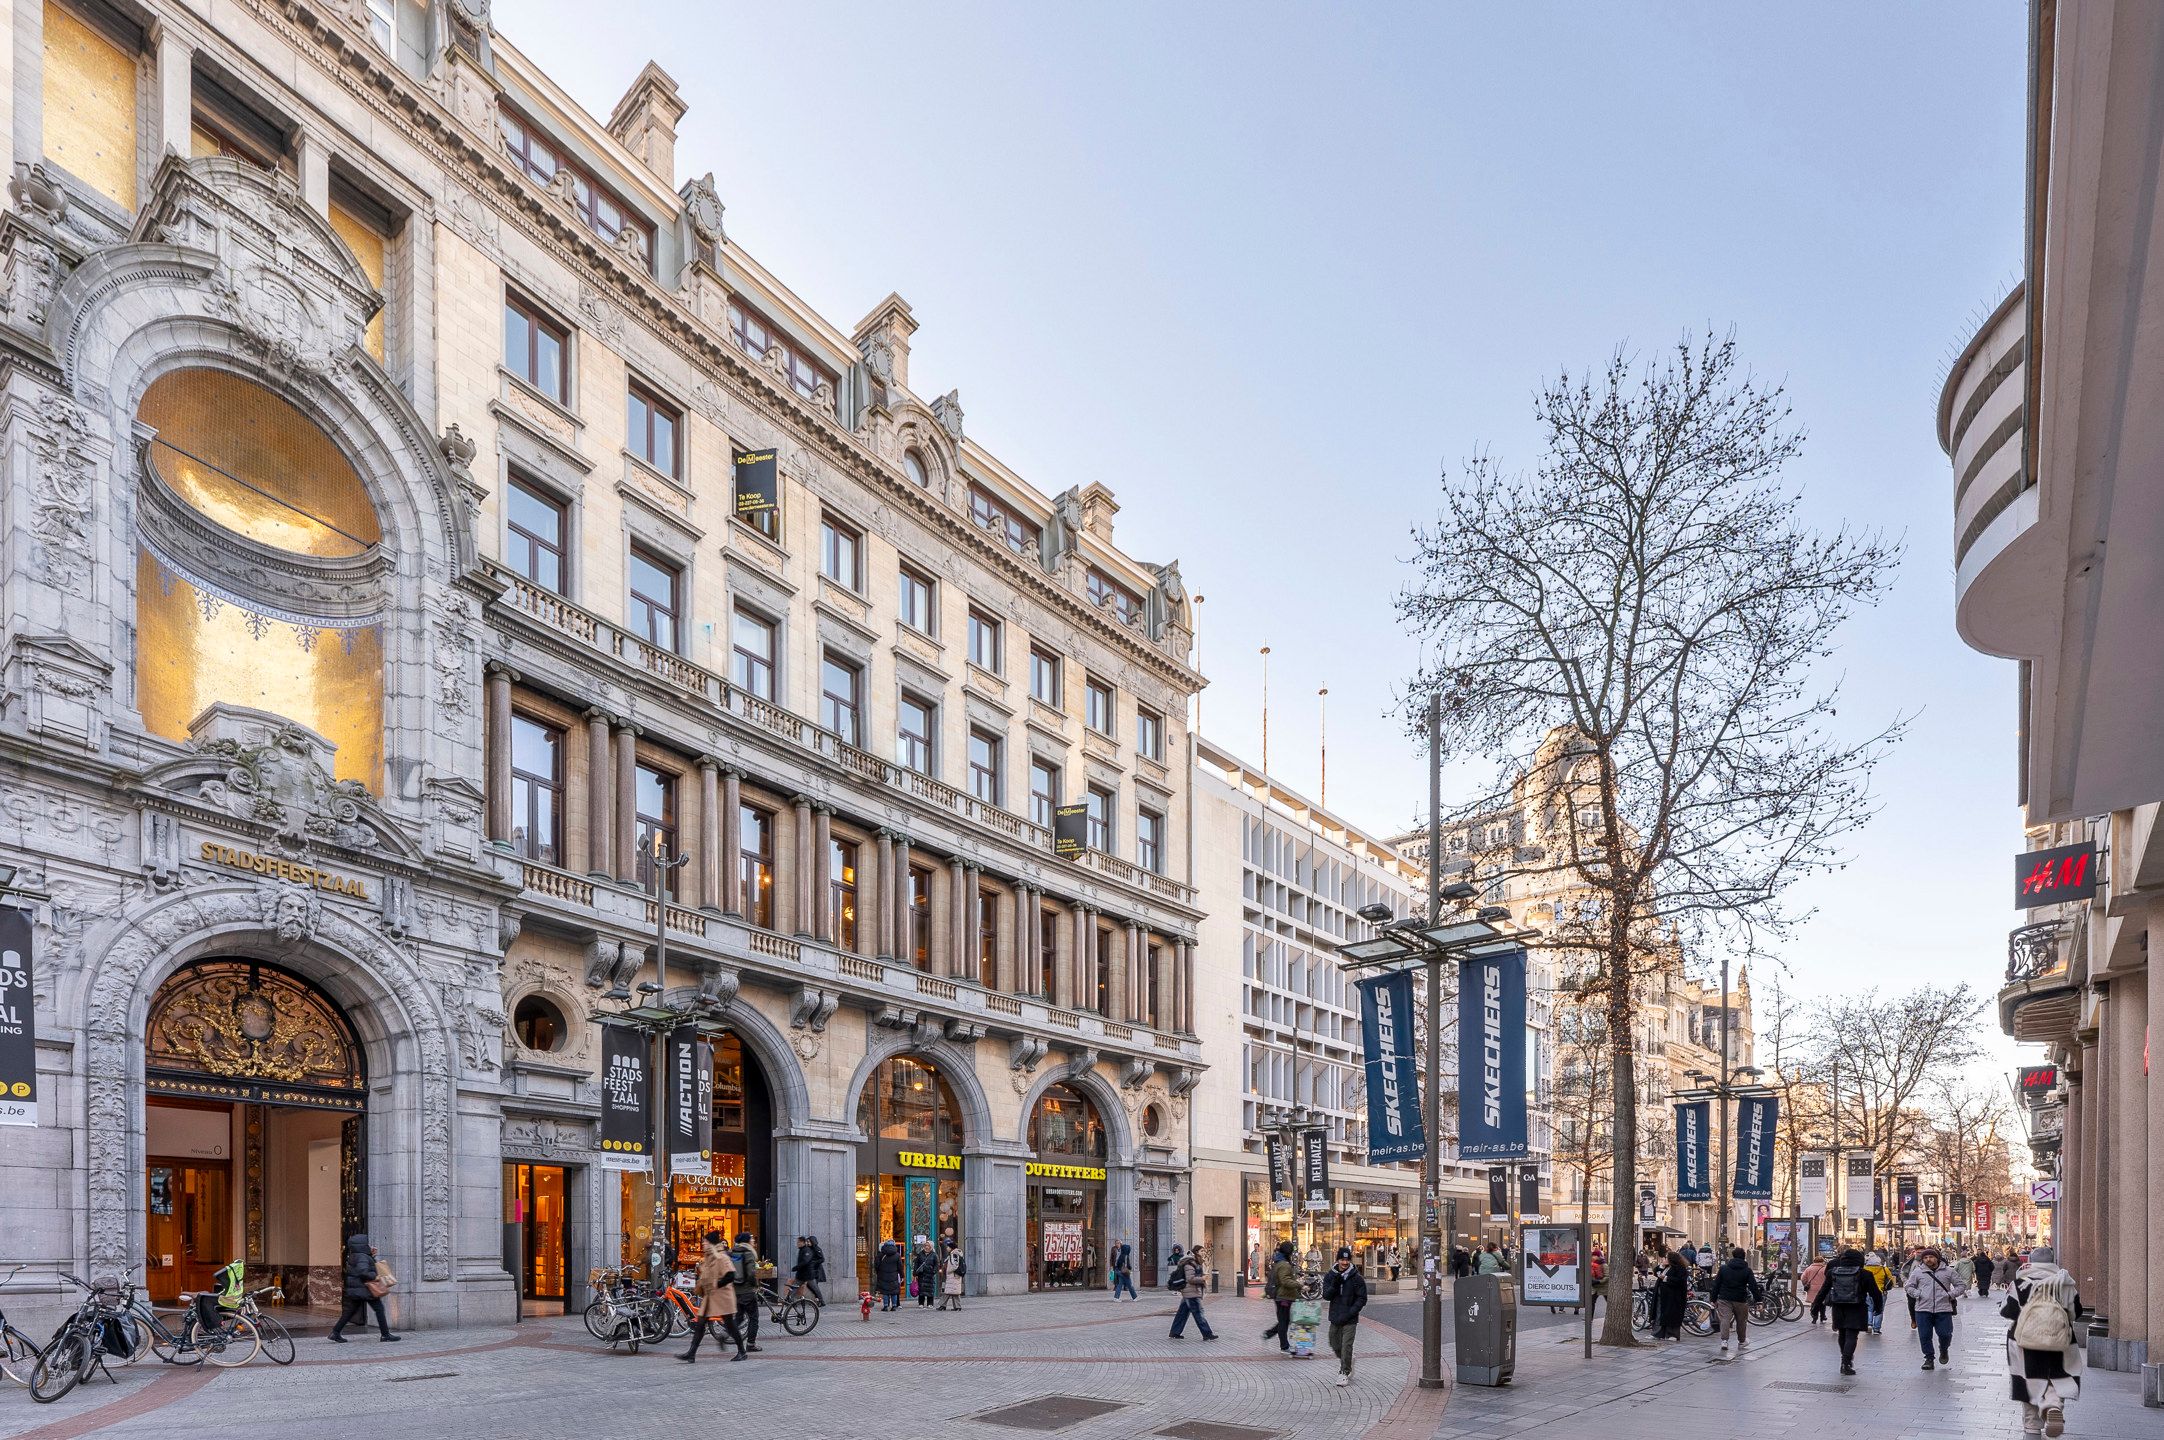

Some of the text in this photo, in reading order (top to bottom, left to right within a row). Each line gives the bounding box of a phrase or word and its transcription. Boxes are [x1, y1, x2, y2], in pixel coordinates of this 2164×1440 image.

[201, 841, 369, 899] STADSFEESTZAAL
[2022, 853, 2089, 895] H&M
[1484, 965, 1500, 1129] SKECHERS
[1375, 986, 1403, 1137] SKECHERS
[609, 1066, 643, 1082] STADS
[2024, 1070, 2054, 1087] H&M
[603, 1077, 634, 1092] FEEST
[611, 1090, 640, 1105] ZAAL
[611, 1103, 640, 1113] SHOPPING
[1371, 1143, 1425, 1157] meir-as.be
[1463, 1141, 1525, 1154] meir-as.be
[1686, 1108, 1697, 1189] SKECHERS
[1748, 1101, 1764, 1187] SKECHERS
[899, 1151, 962, 1170] URBAN
[1311, 1138, 1323, 1182] DELHAIZE
[1025, 1162, 1106, 1181] OUTFITTERS
[1978, 1204, 1987, 1229] HEMA
[1045, 1223, 1083, 1232] SALE SALE
[1047, 1253, 1082, 1261] OFF OFF
